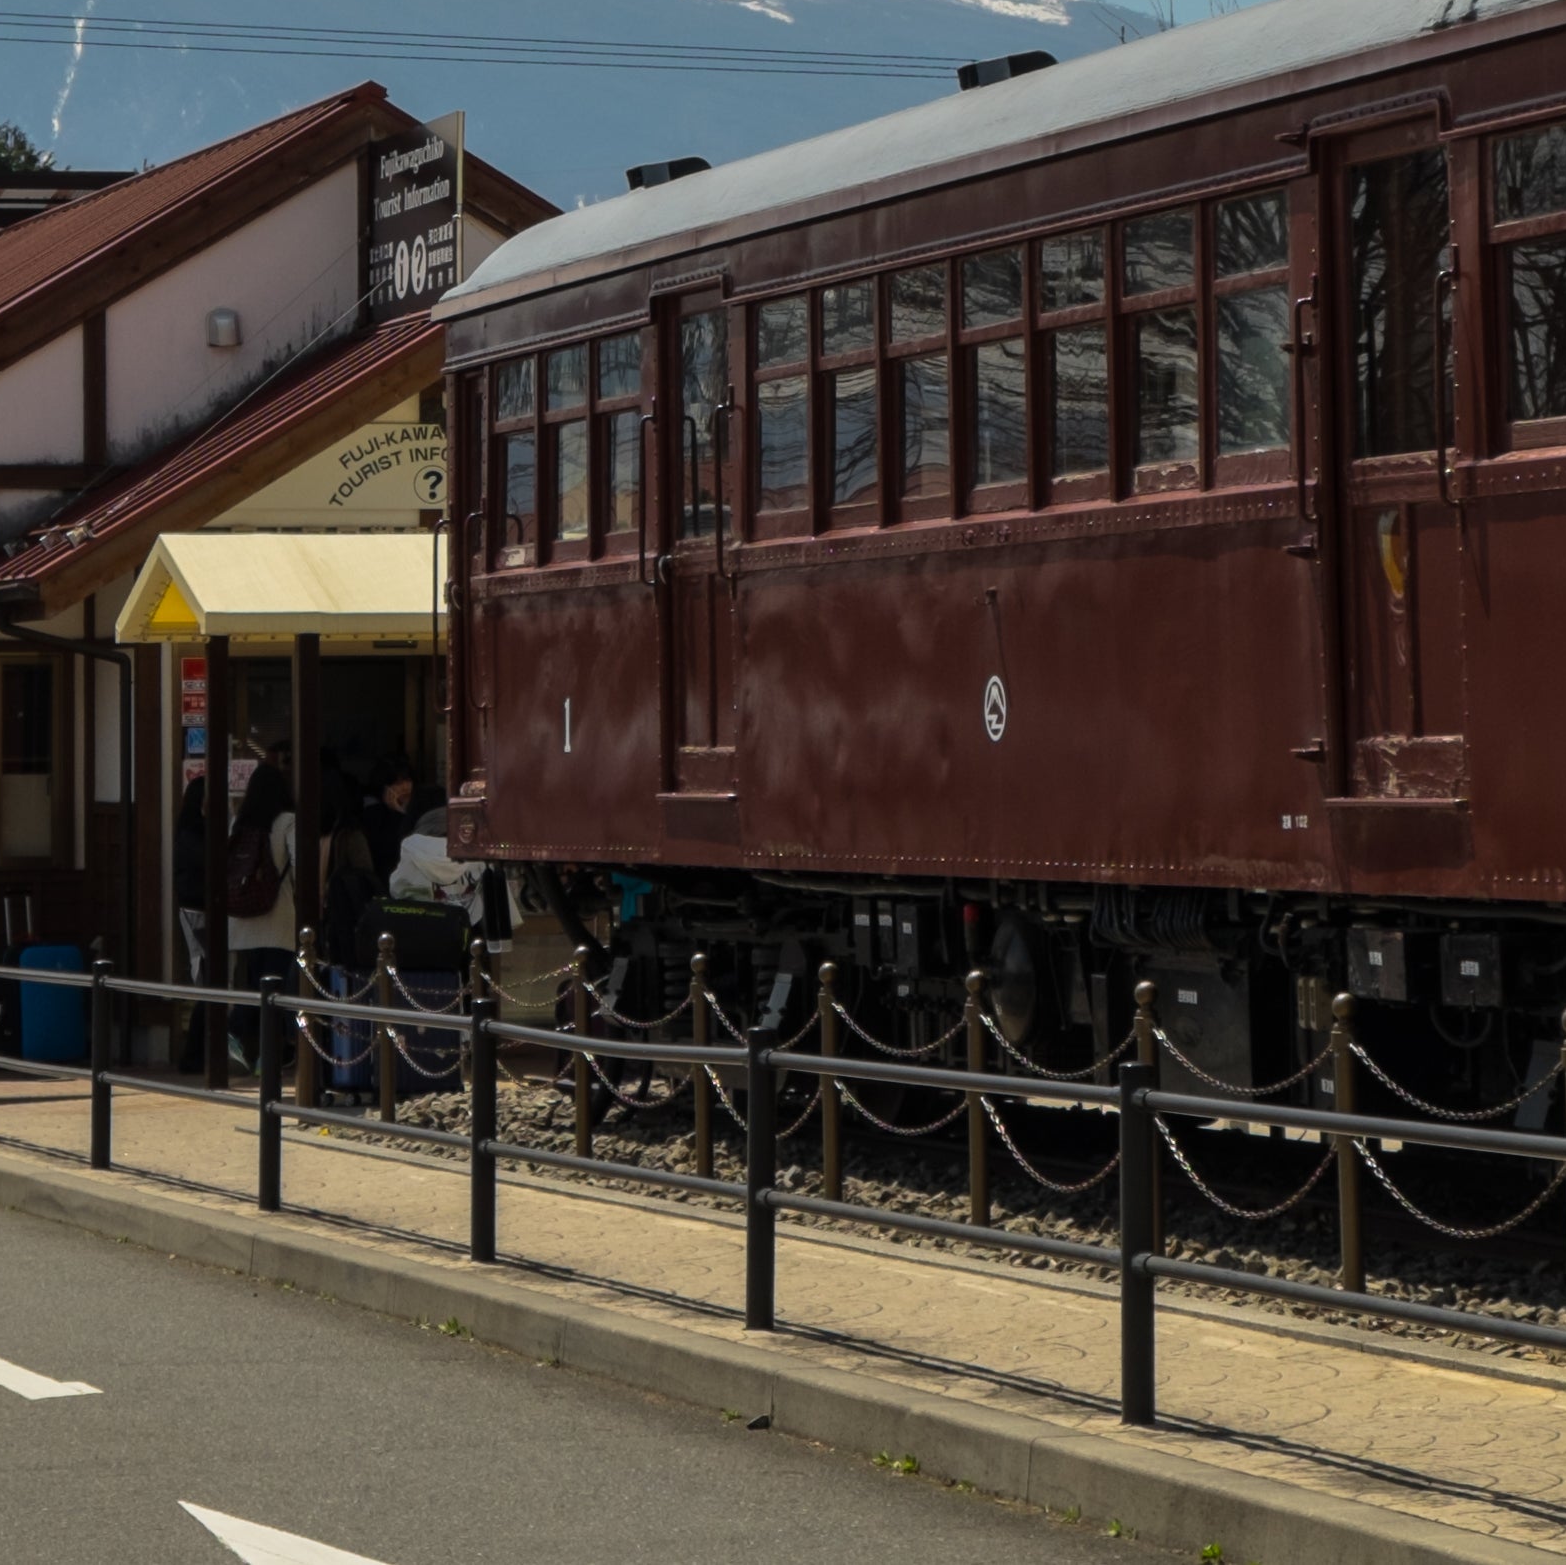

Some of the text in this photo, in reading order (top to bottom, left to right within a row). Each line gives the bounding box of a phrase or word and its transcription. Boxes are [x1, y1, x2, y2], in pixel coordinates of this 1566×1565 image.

[380, 136, 444, 183] Fujikawaguchiko
[373, 176, 450, 221] Tourist Information
[328, 450, 403, 507] TOURIST
[564, 697, 571, 753] 1
